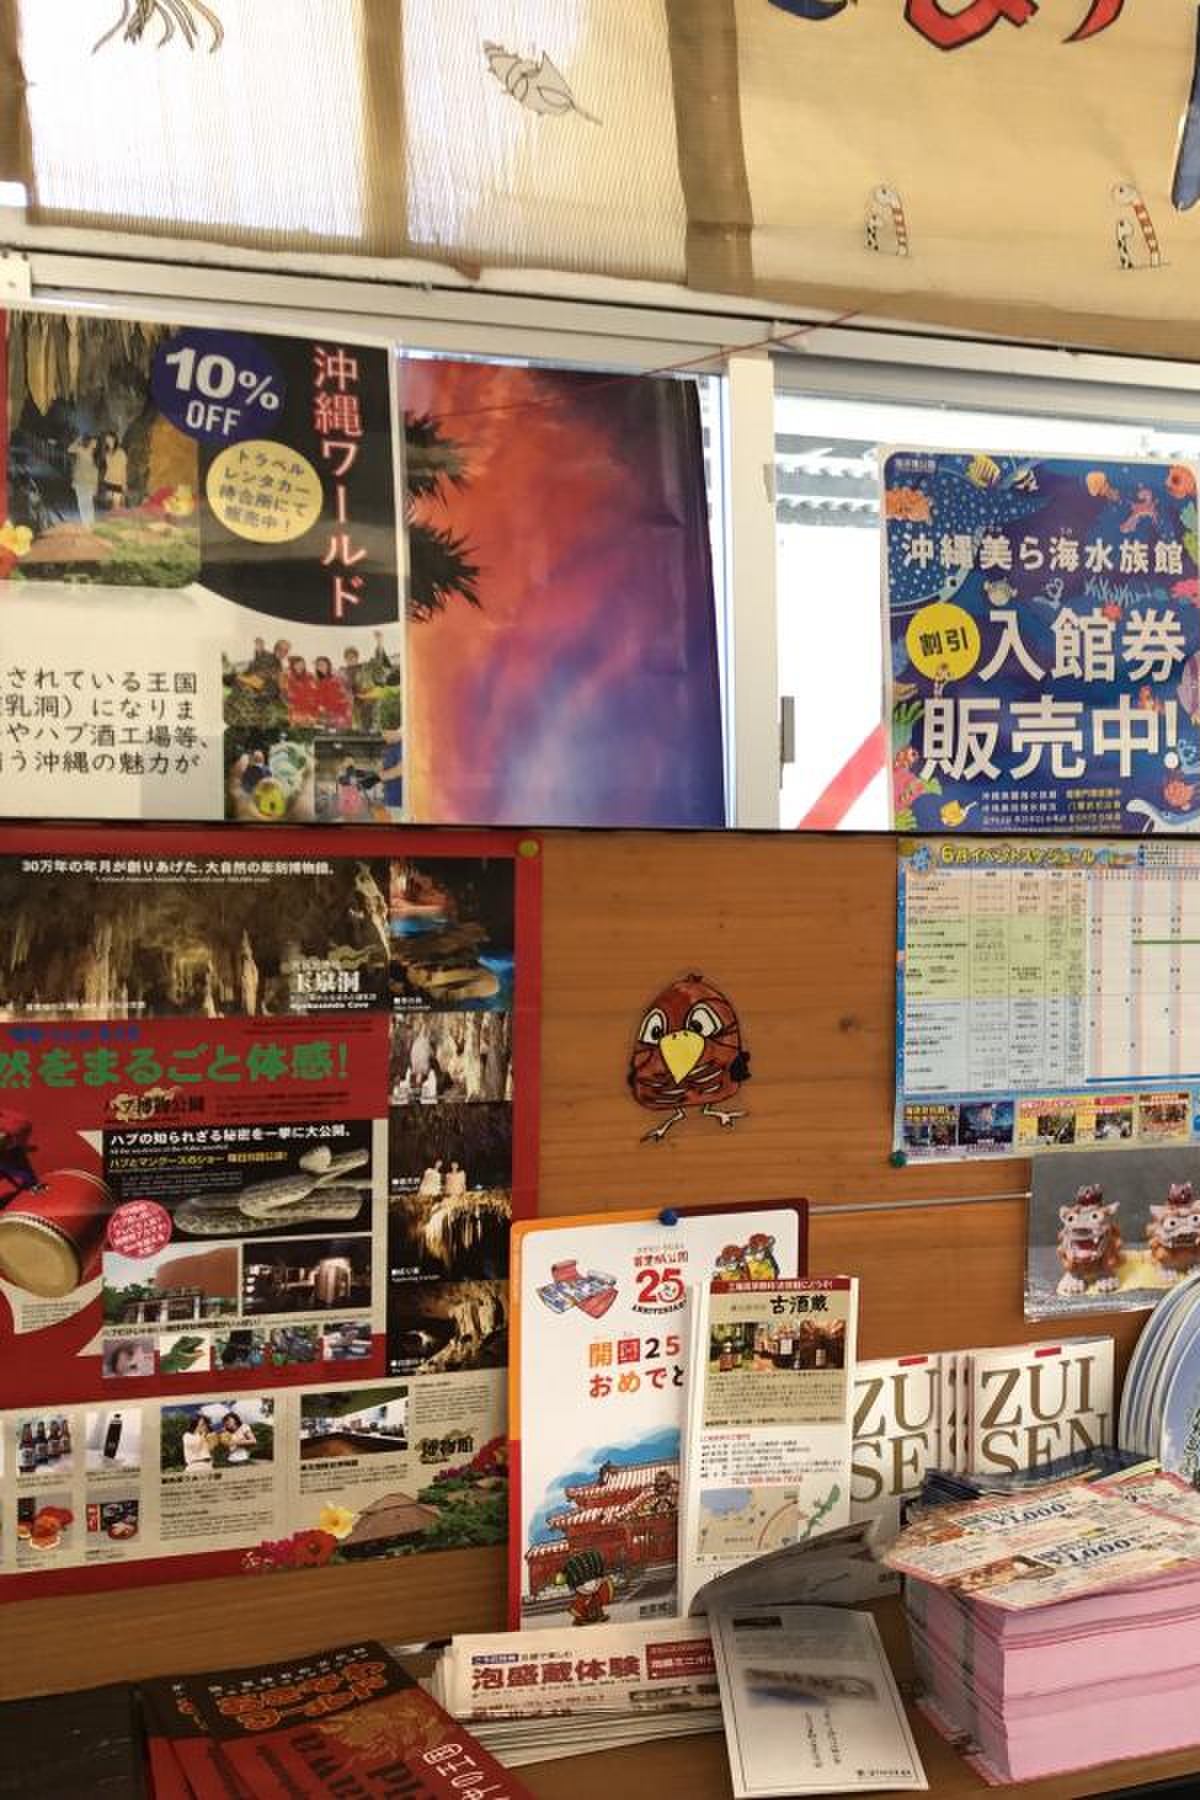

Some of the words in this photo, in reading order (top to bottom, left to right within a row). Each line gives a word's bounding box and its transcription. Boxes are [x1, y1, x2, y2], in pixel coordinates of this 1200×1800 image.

[165, 347, 280, 411] 10%
[186, 400, 241, 437] OFF
[311, 346, 367, 618] 沖縄ワールド
[903, 533, 1184, 576] 沖縄美ら海水族館
[919, 627, 969, 658] 割引
[977, 606, 1187, 684] 入館券
[7, 667, 198, 694] されている王国
[0, 694, 194, 720] 乳洞）になりま
[919, 694, 1180, 781] 販売中!
[0, 750, 201, 775] う沖縄の魅力が
[635, 1268, 685, 1303] 25
[589, 1335, 681, 1368] 開園25
[589, 1366, 684, 1398] おめでと
[979, 1356, 1096, 1430] ZUI
[471, 1655, 641, 1691] 泡盛蔵体験
